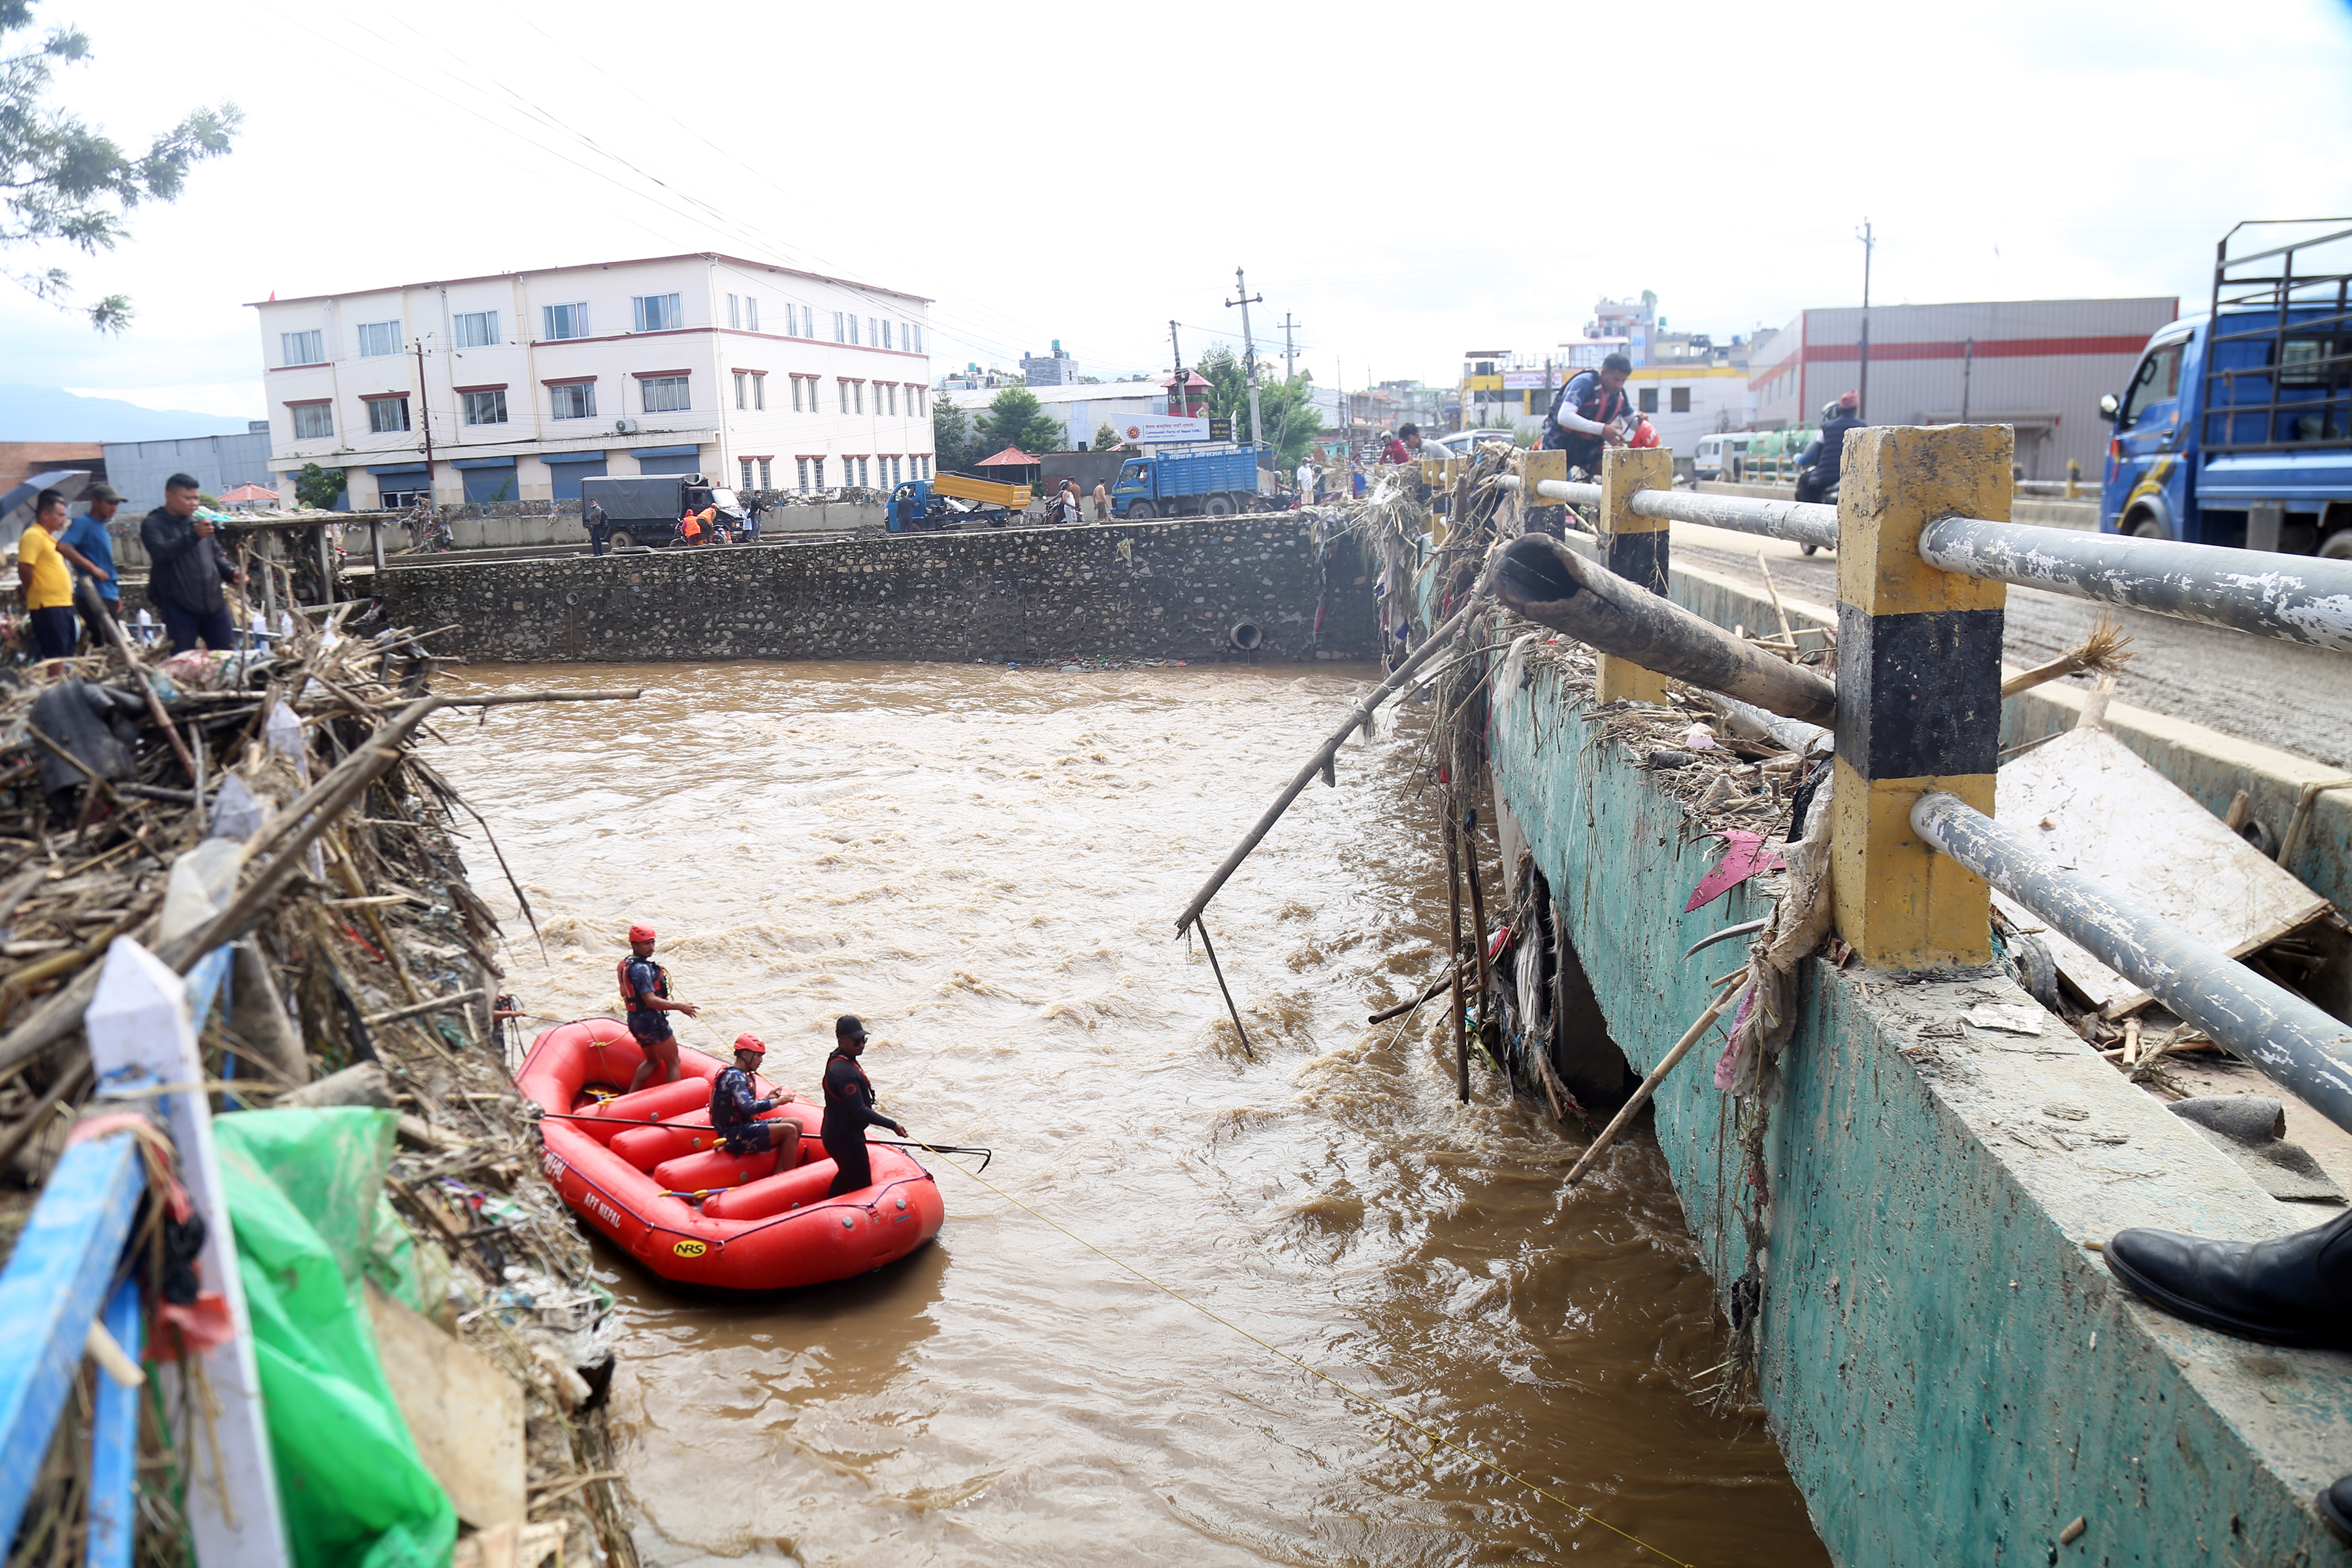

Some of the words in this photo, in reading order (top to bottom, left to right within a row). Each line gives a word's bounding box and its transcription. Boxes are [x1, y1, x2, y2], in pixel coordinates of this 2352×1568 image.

[583, 1192, 600, 1211] APF
[598, 1202, 621, 1228] NEPAL
[676, 1244, 704, 1254] NRS
